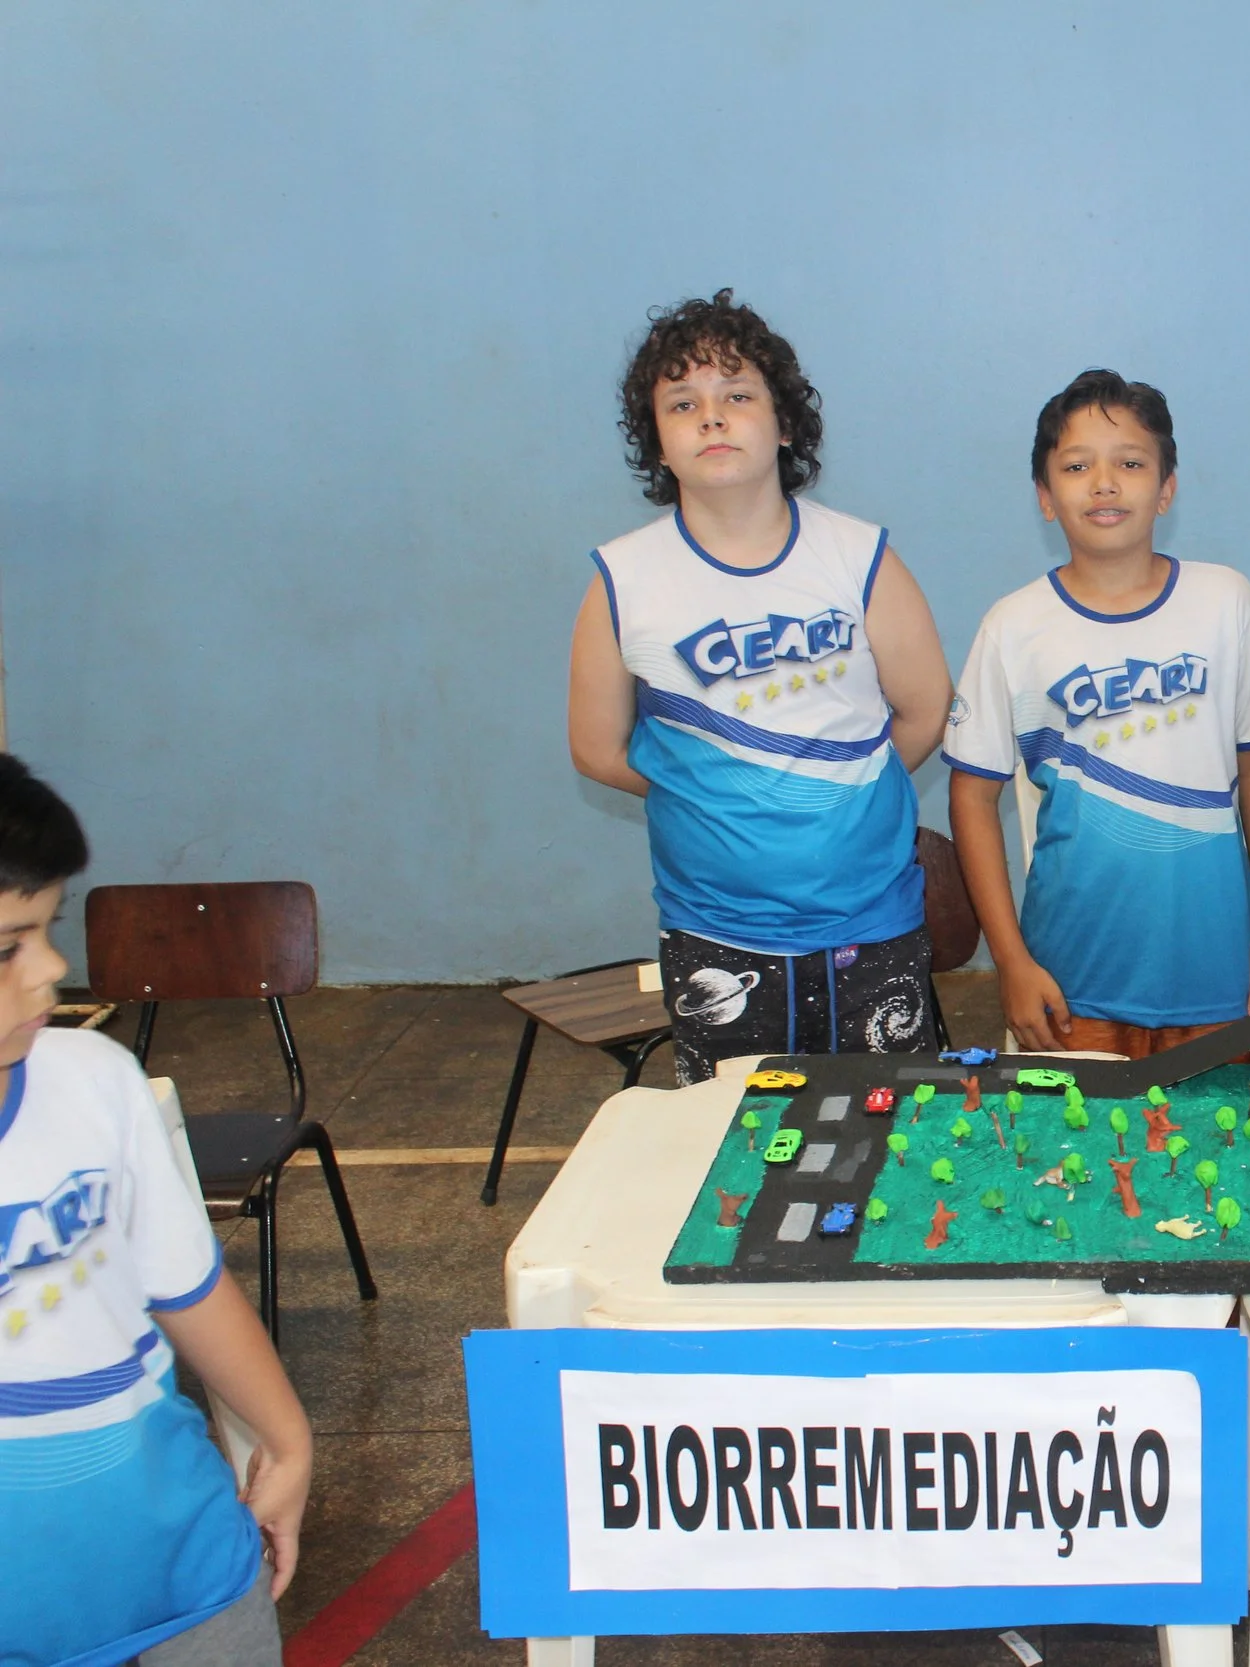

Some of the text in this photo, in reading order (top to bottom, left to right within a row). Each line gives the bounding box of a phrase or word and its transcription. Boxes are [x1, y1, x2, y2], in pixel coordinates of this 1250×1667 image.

[693, 611, 855, 676] CEART
[1062, 655, 1208, 718] CEART
[0, 1171, 108, 1290] ART
[598, 1405, 1170, 1558] BIORREMEDIAÇÃO
